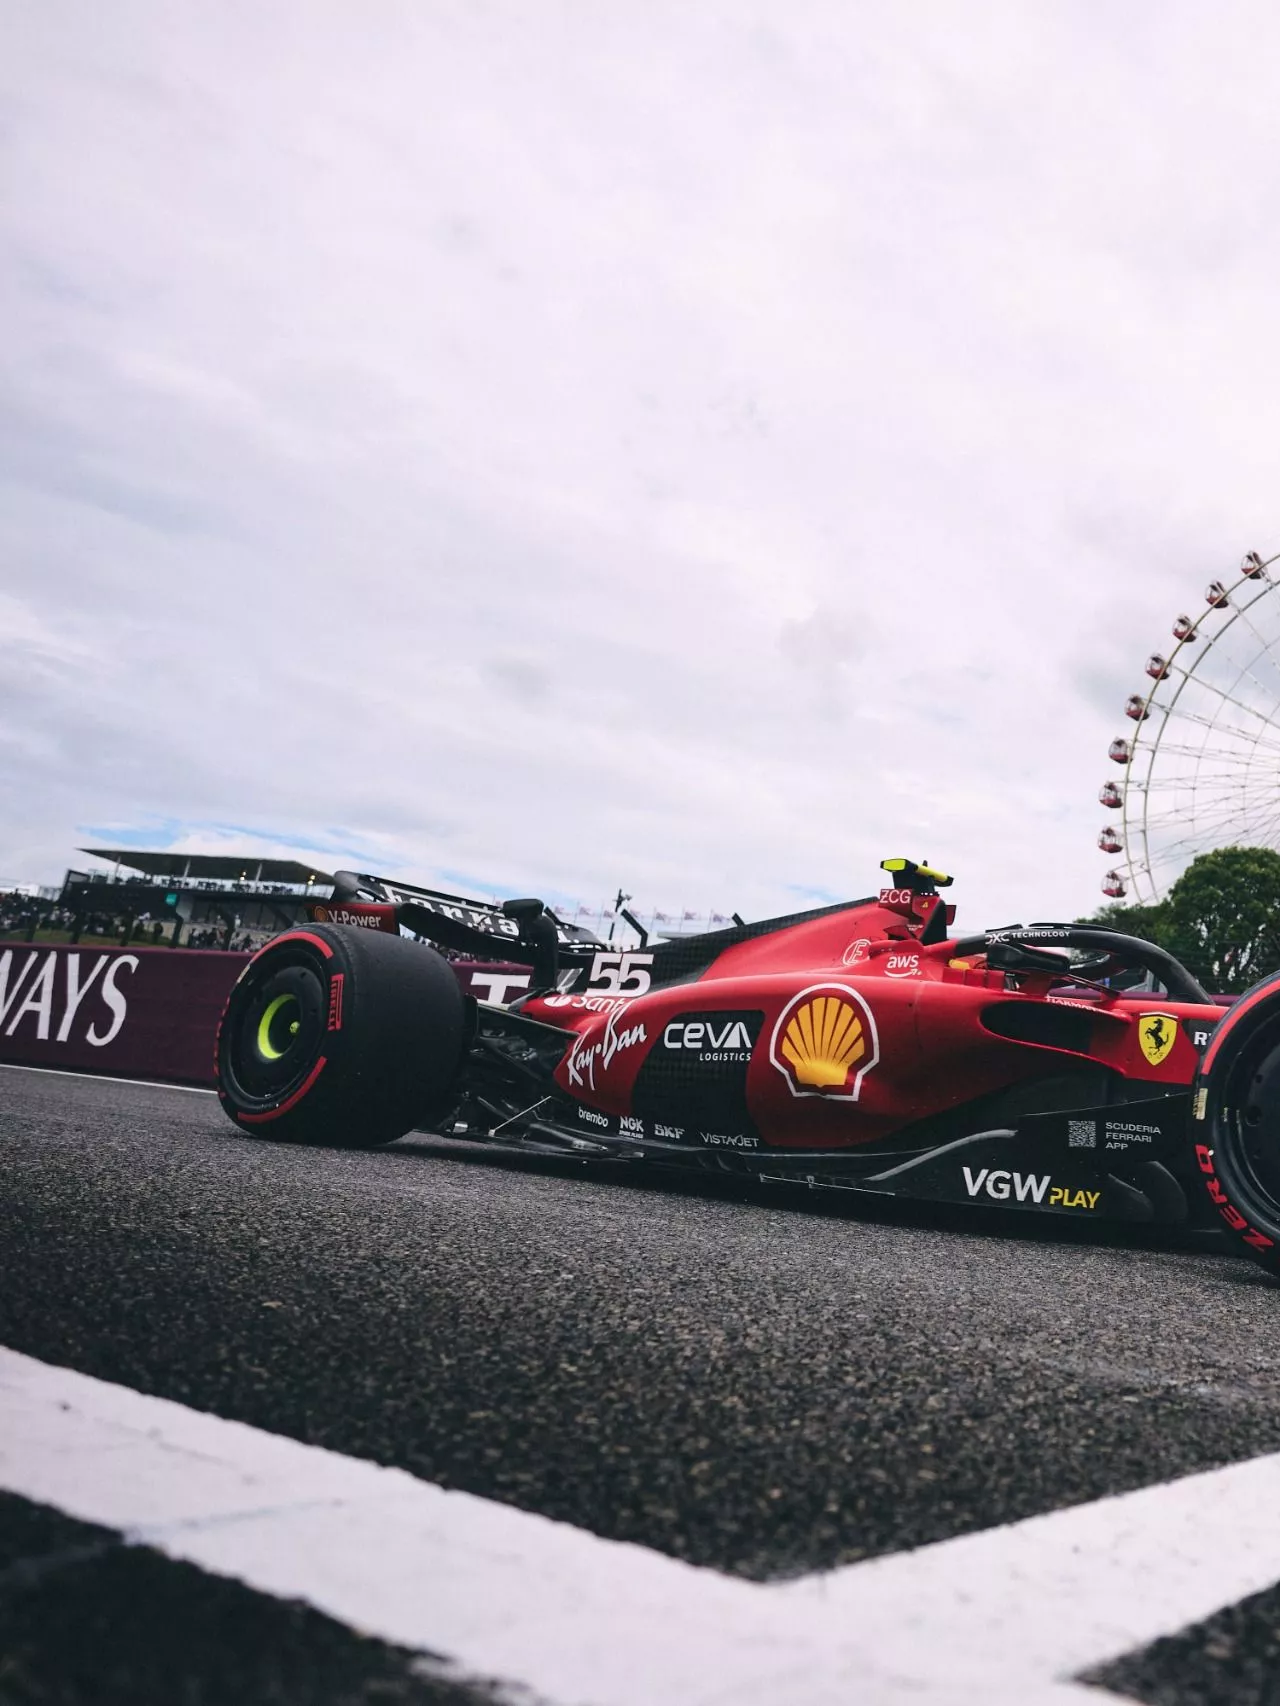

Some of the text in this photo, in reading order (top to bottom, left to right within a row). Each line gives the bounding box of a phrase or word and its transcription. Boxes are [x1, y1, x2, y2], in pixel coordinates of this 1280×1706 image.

[880, 889, 912, 904] ZCG
[328, 909, 382, 928] V-Power
[1012, 931, 1070, 939] TECHNOLOGY
[887, 954, 919, 969] aws
[584, 953, 654, 998] 55
[699, 1052, 752, 1061] LOGISTICS
[578, 1106, 609, 1128] brembo
[620, 1115, 645, 1132] NGK
[654, 1123, 685, 1139] SKF
[1105, 1122, 1161, 1134] SCUDERIA
[1105, 1132, 1152, 1143] FERRARI
[1105, 1141, 1128, 1150] APP
[962, 1166, 1100, 1209] VGW PLAY
[1195, 1144, 1275, 1253] ZERO
